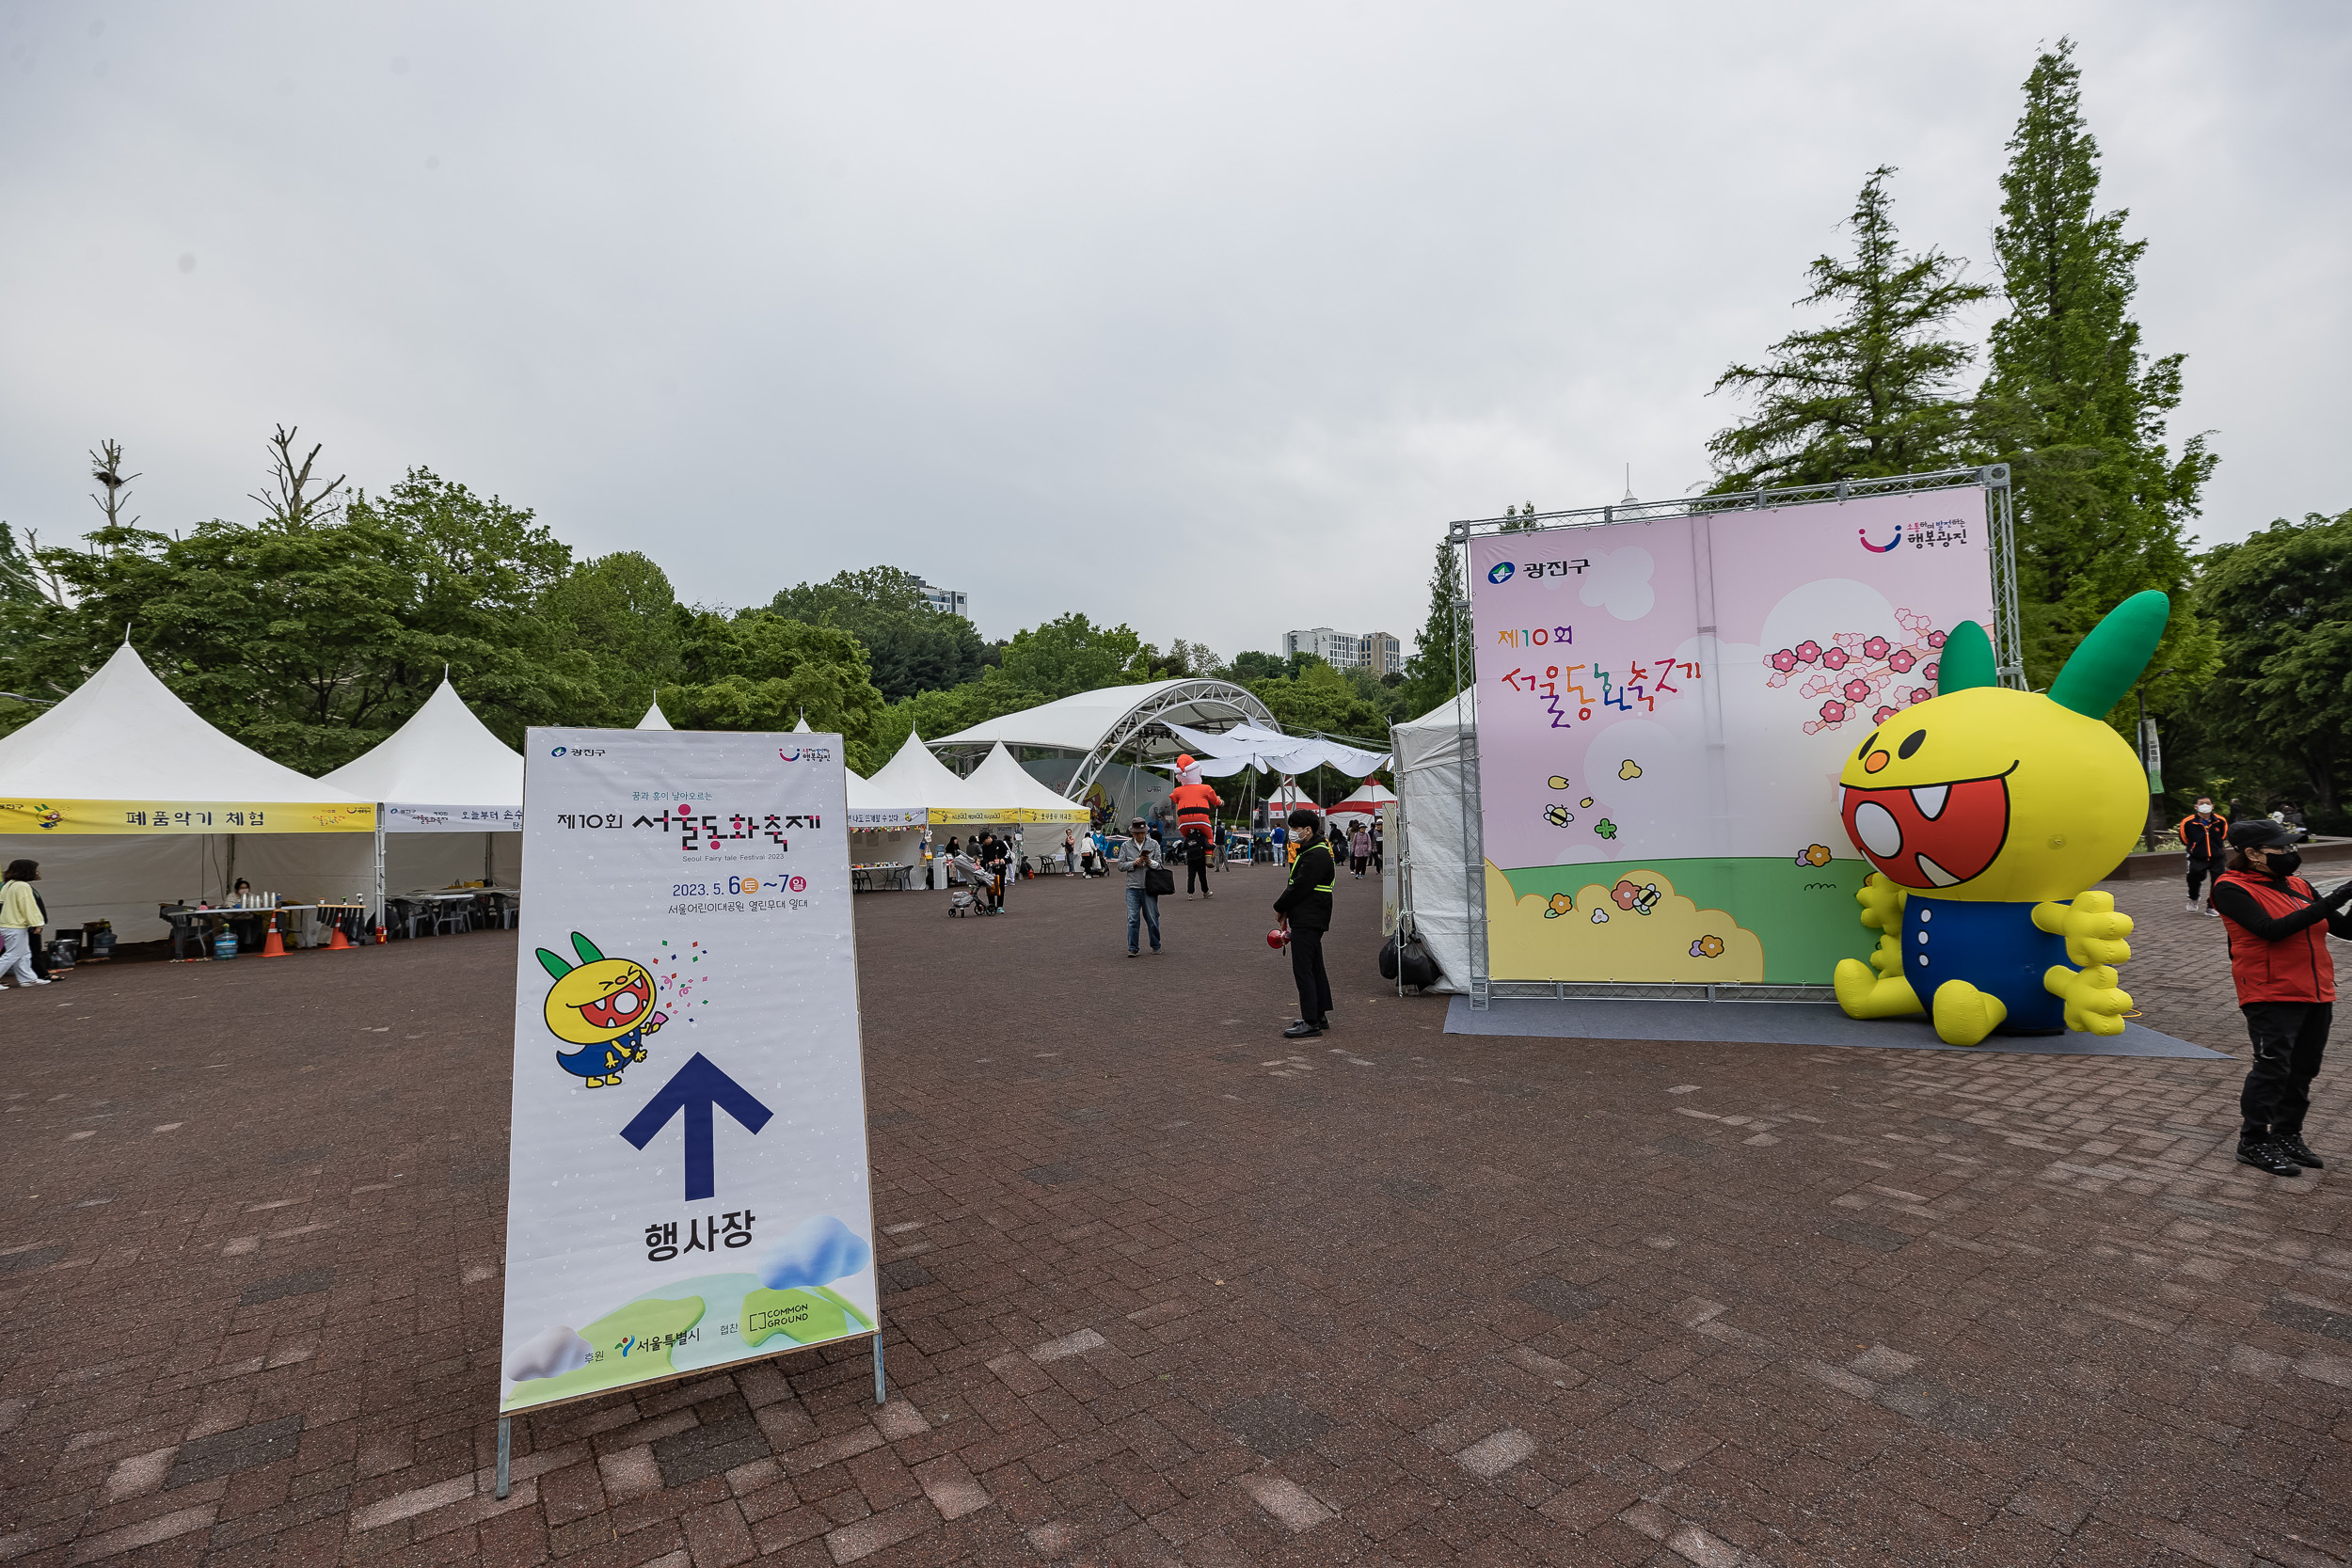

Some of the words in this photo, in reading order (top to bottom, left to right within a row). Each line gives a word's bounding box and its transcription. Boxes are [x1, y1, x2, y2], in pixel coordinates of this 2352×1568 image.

[1906, 520, 1934, 532] 소통하며
[1935, 518, 1965, 531] 발전하는
[1907, 529, 1967, 549] 행복광진
[1523, 558, 1591, 578] 광진구
[1498, 626, 1573, 648] 제10회
[1502, 658, 1701, 729] 서울동화축제
[570, 748, 606, 757] 광진구
[803, 752, 831, 762] 행복광진
[632, 791, 649, 801] 꿈과
[653, 791, 669, 801] 흥이
[672, 791, 713, 801] 날아오르는
[126, 811, 213, 826] 폐품악기
[226, 811, 264, 826] 체험
[461, 810, 499, 820] 오늘부터
[557, 814, 623, 830] 제10회
[631, 803, 821, 852] 서울동화축제
[673, 883, 709, 896] 2023.
[713, 882, 724, 895] 5.
[668, 901, 745, 915] 서울어린이대공원
[748, 899, 786, 912] 열린무대
[788, 898, 808, 910] 일대
[644, 1209, 756, 1262] 행사장
[767, 1303, 808, 1318] COMMON
[767, 1313, 809, 1328] GROUND
[584, 1350, 604, 1364] 후원
[636, 1327, 700, 1354] 서울특별시
[720, 1323, 739, 1336] 협찬
